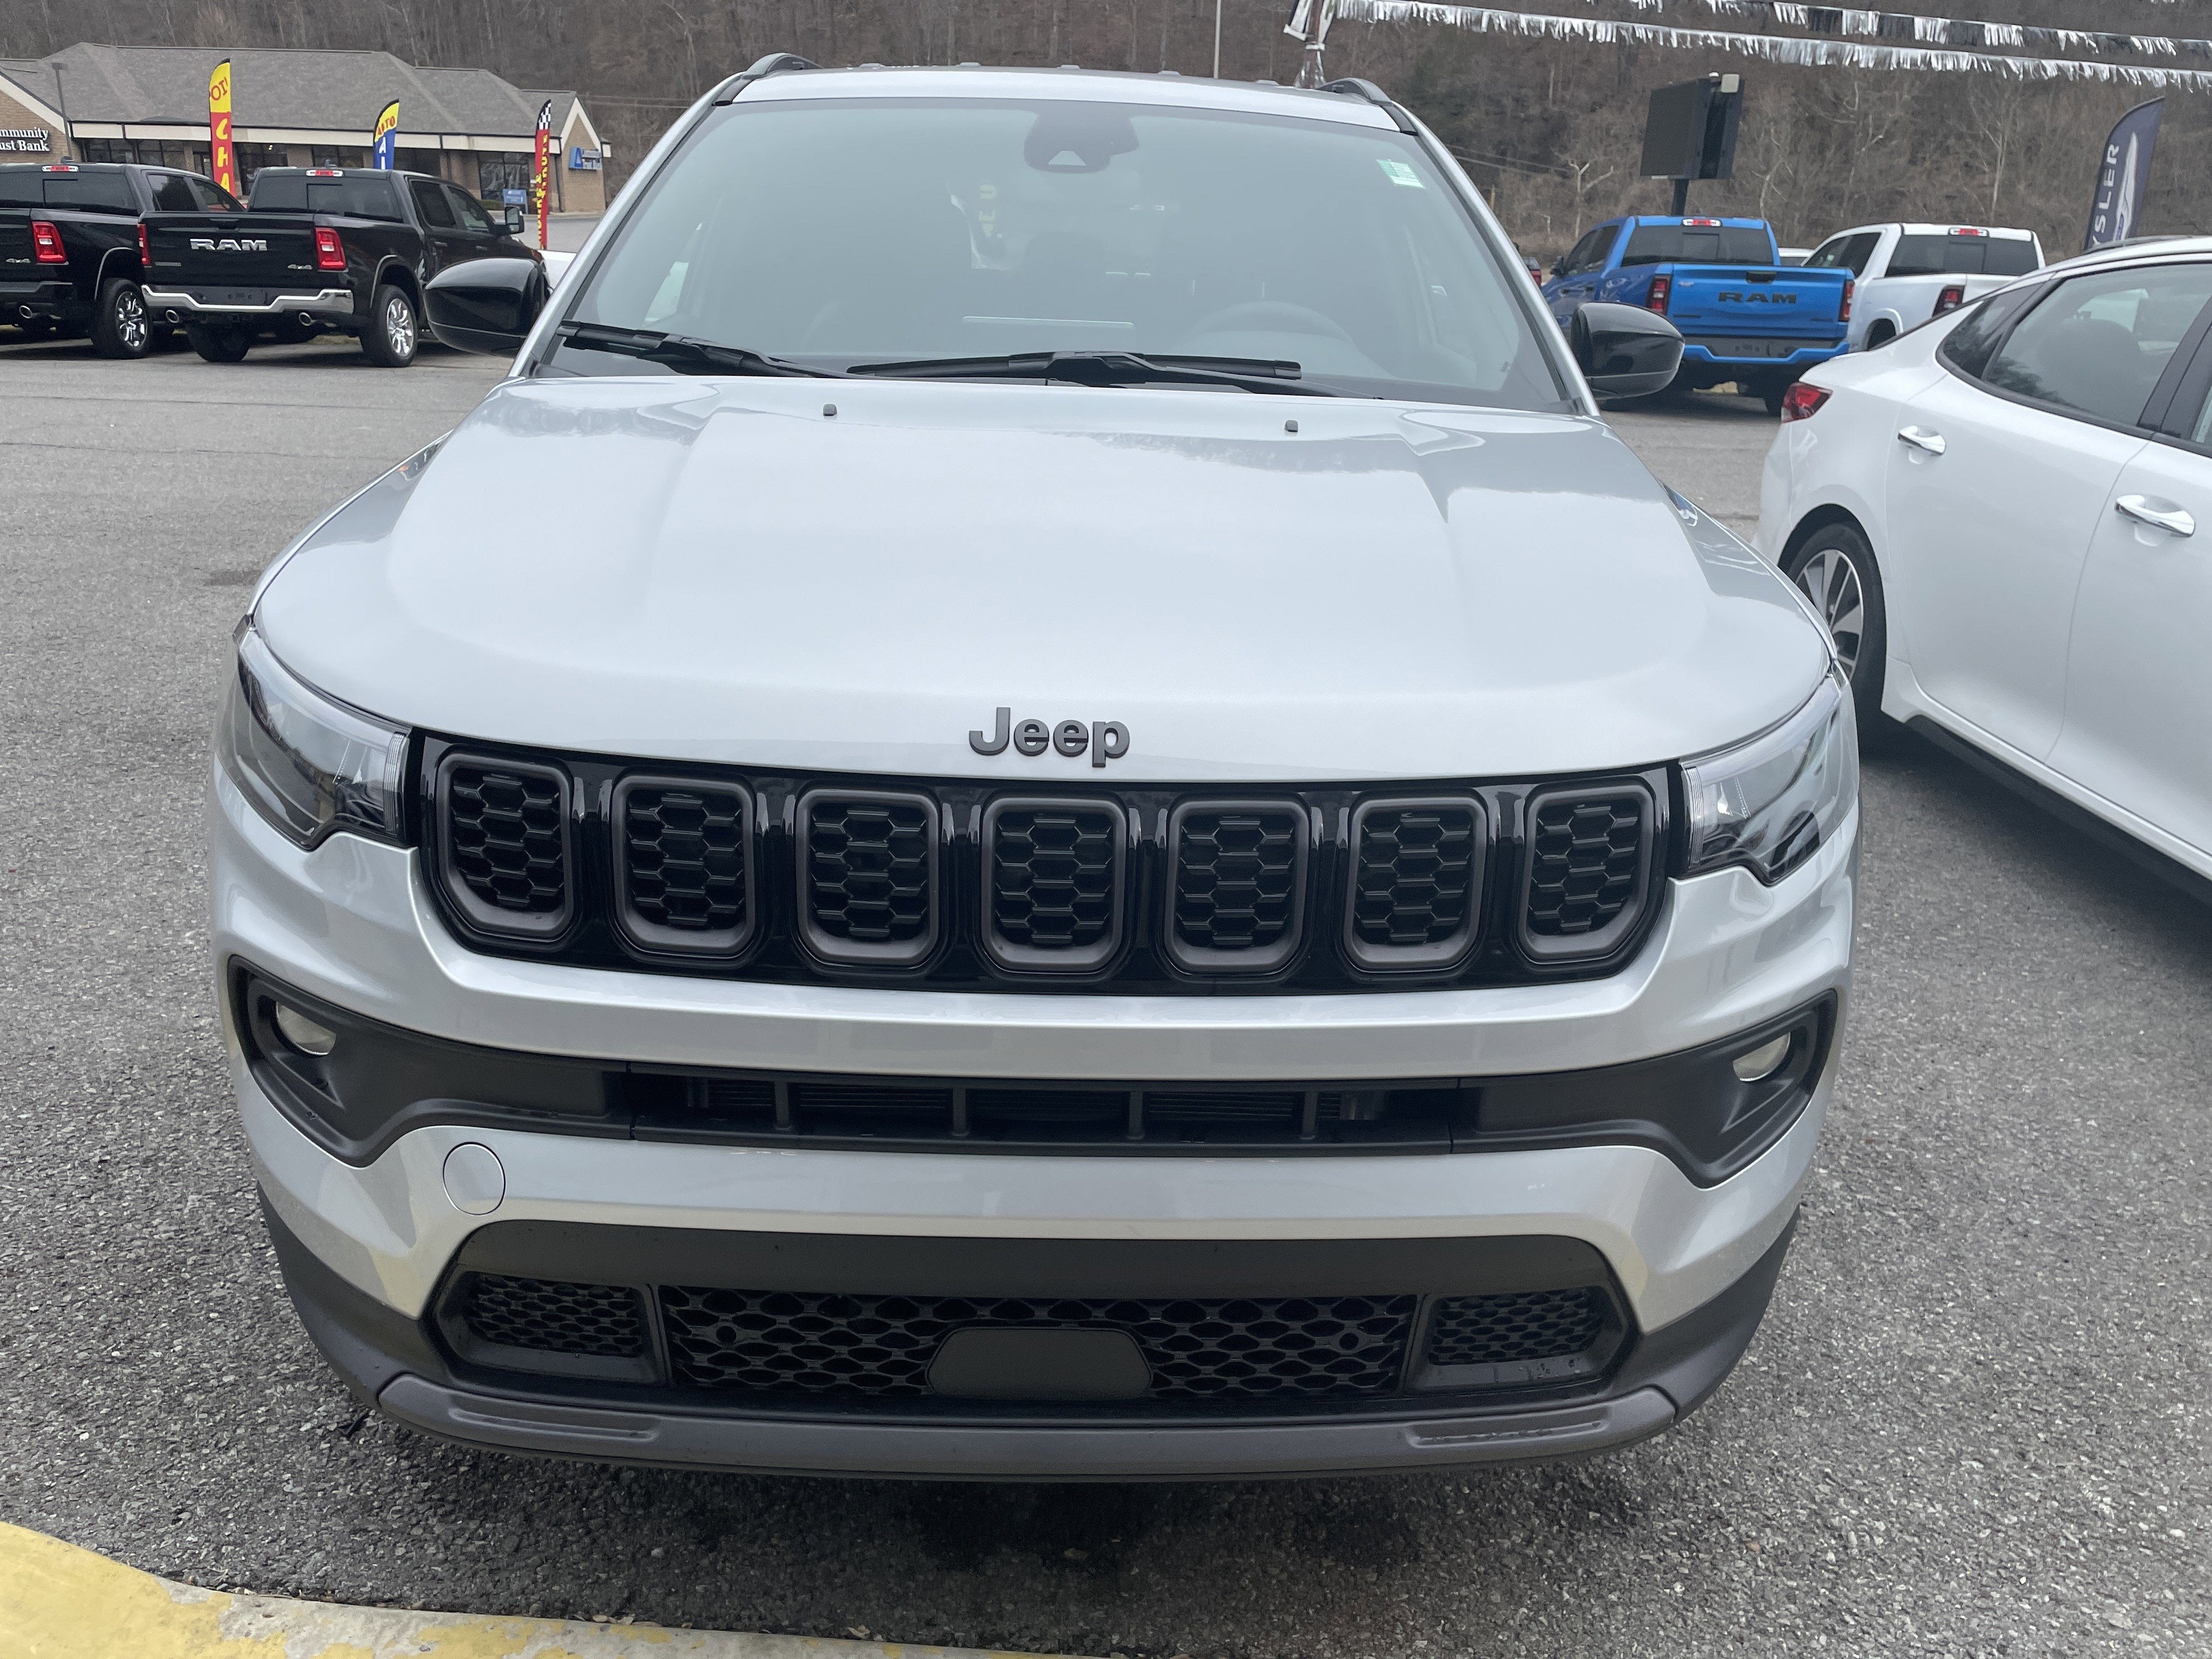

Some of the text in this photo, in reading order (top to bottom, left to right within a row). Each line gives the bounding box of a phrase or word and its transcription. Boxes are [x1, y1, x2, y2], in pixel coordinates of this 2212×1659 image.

[17, 140, 50, 151] Bank
[190, 239, 268, 251] RAM
[1718, 292, 1797, 304] RAM
[968, 707, 1130, 768] Jeep
